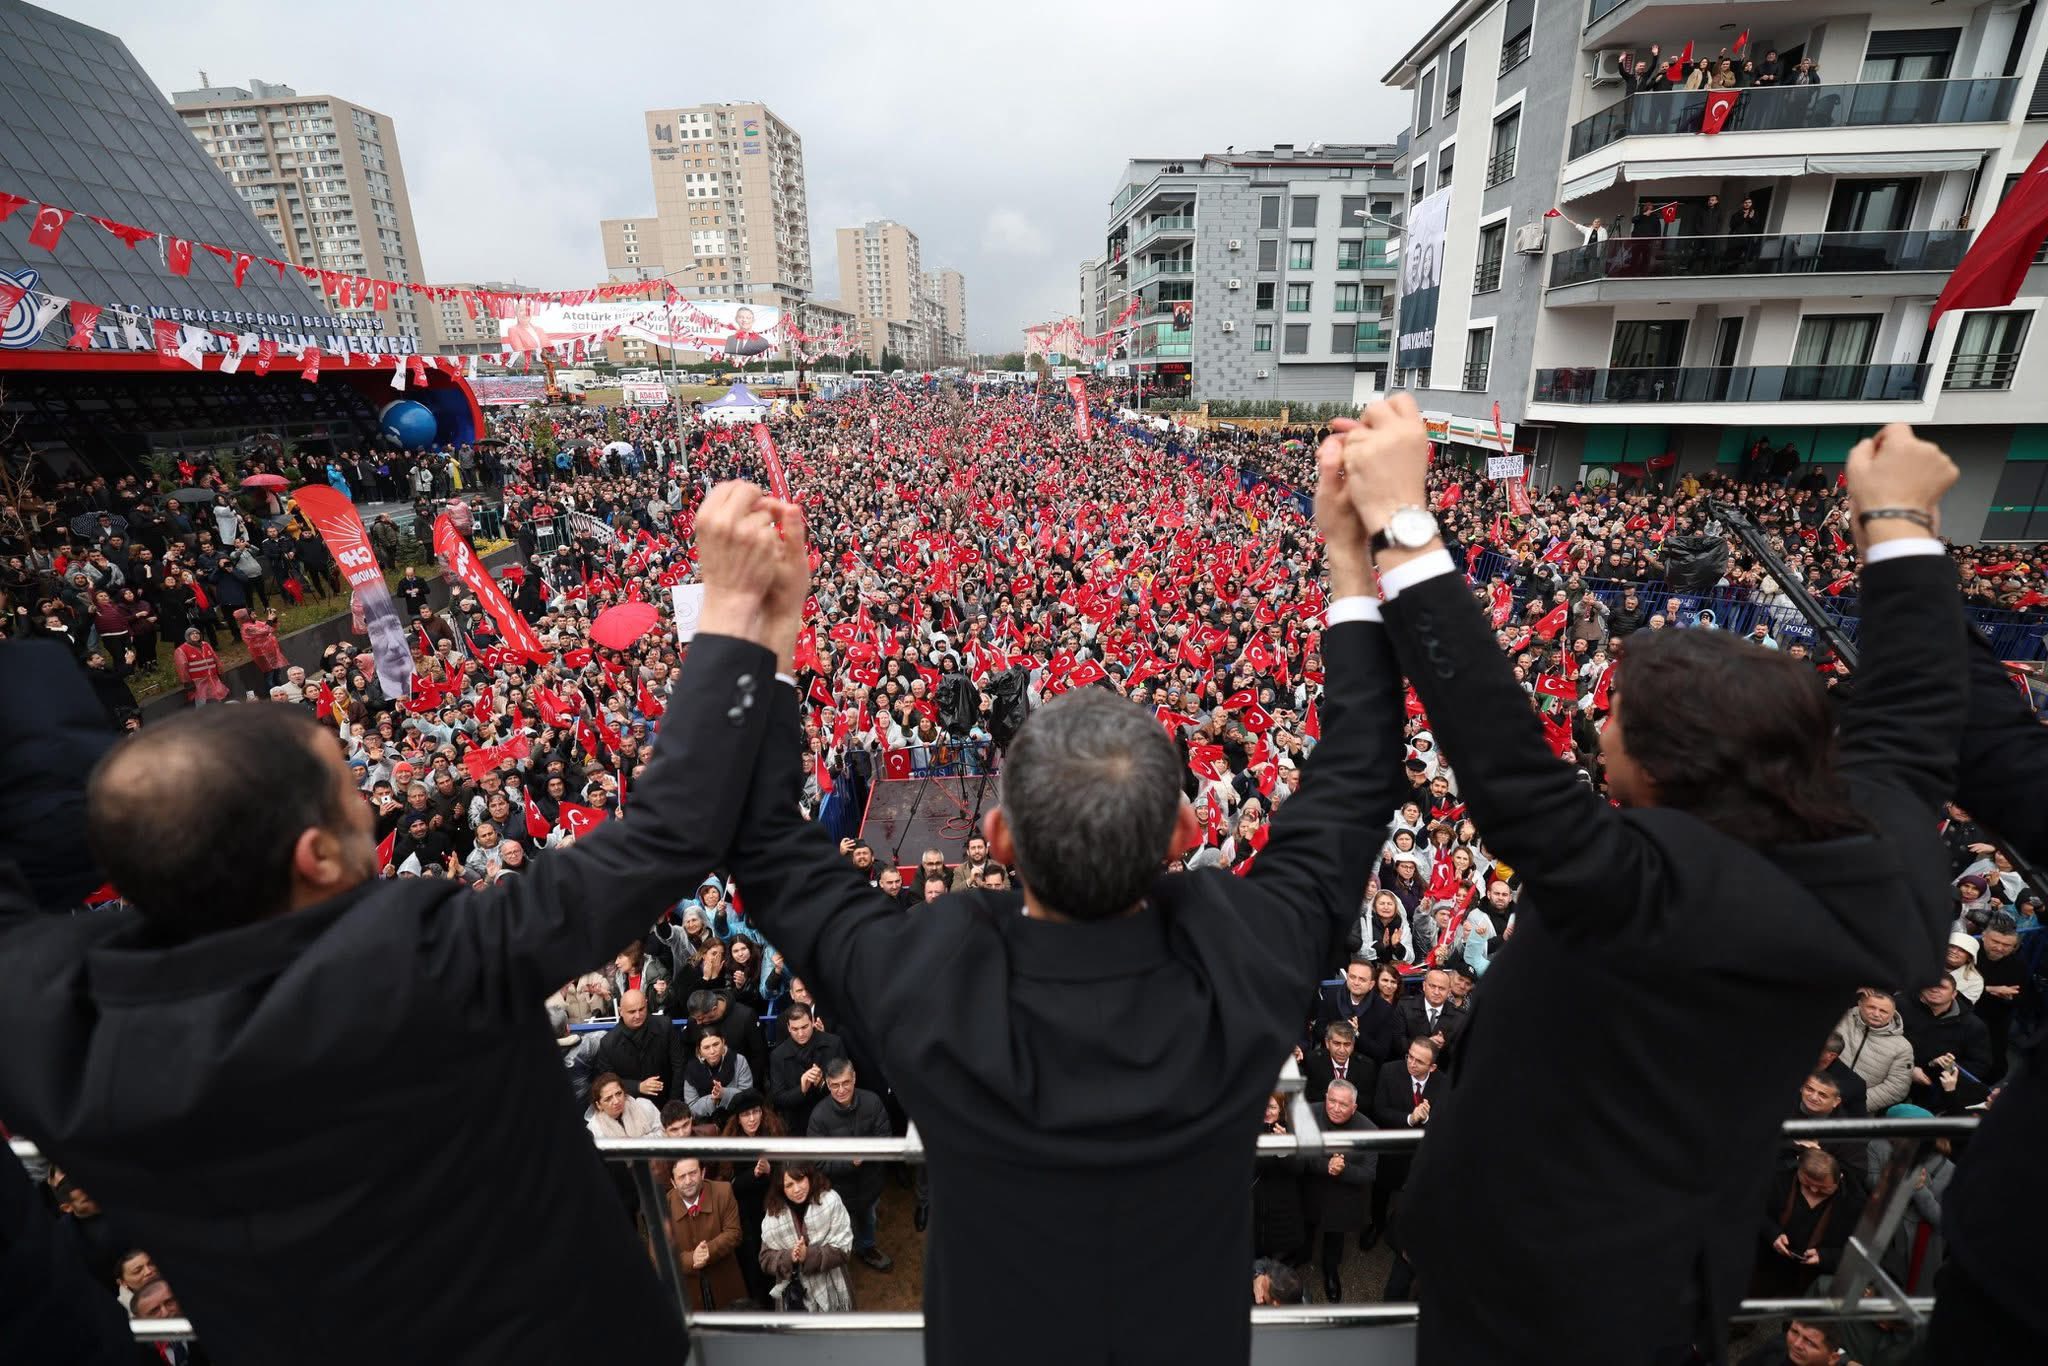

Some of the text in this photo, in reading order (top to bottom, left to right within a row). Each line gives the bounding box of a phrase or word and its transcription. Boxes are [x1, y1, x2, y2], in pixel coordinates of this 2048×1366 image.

[150, 305, 297, 327] MERKEZEFENDİ
[302, 315, 385, 331] BELEDİYESİ
[562, 311, 612, 321] Atatürk
[326, 333, 418, 354] MERKEZİ
[639, 391, 664, 399] ADALET
